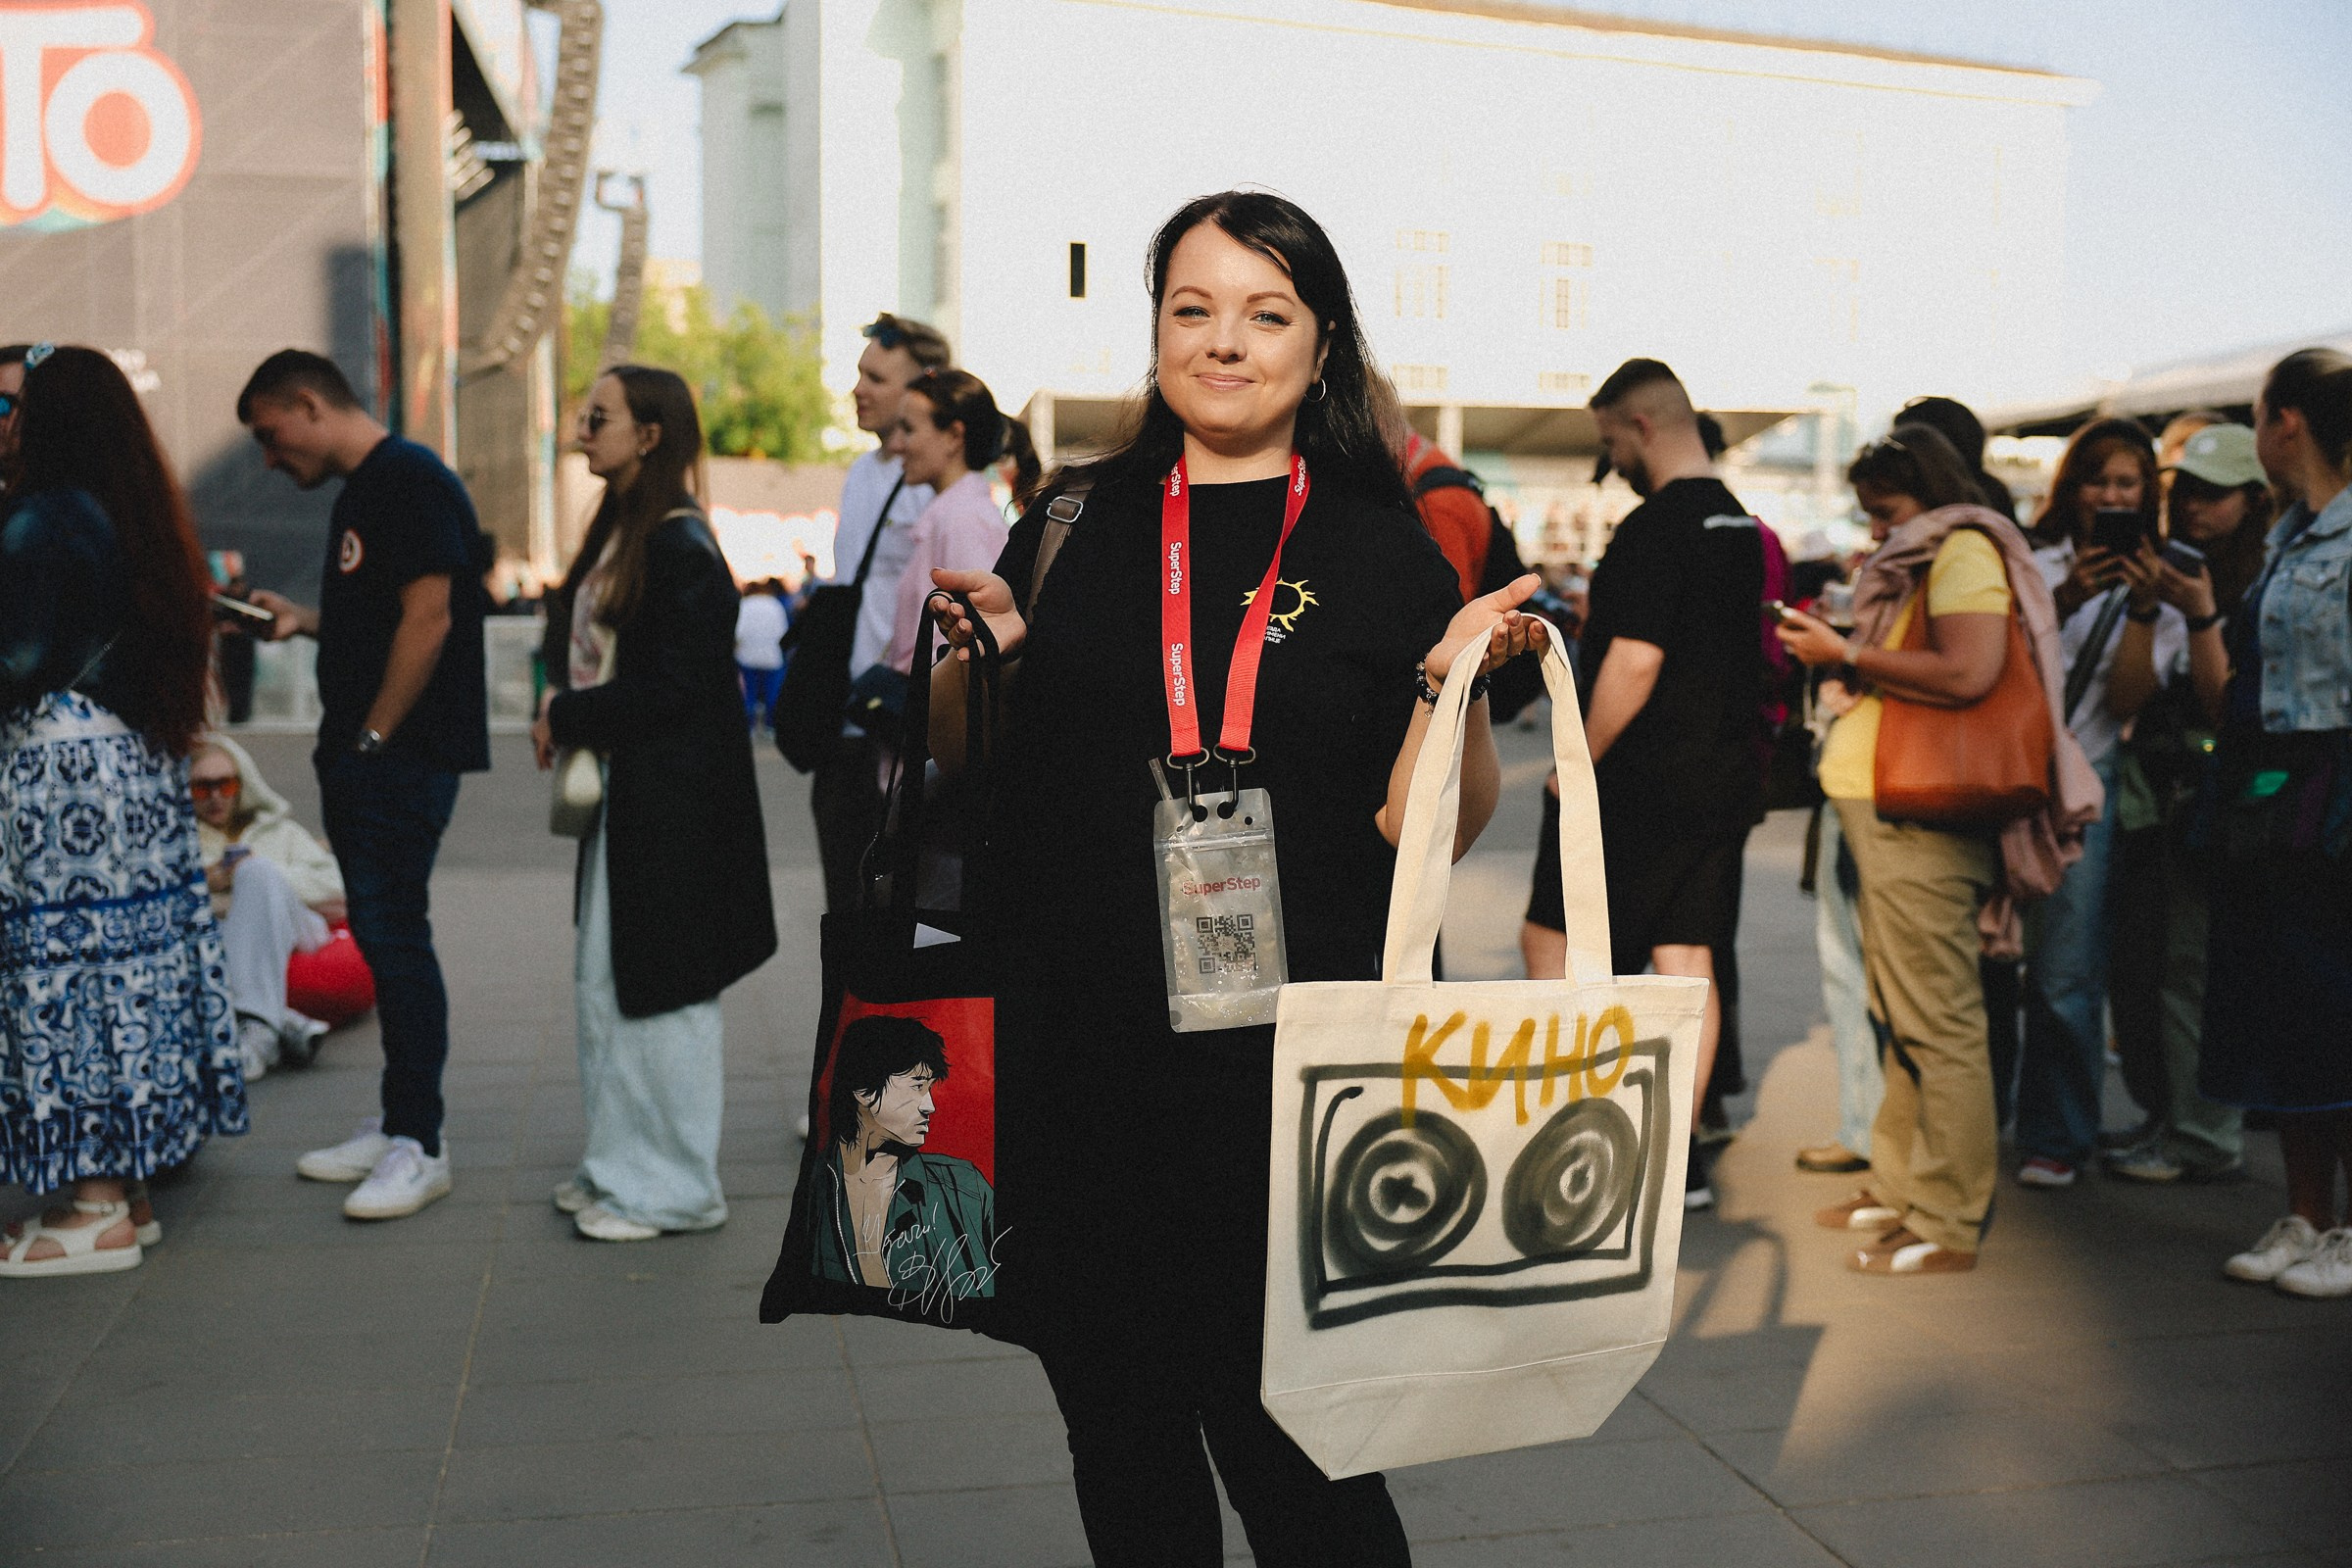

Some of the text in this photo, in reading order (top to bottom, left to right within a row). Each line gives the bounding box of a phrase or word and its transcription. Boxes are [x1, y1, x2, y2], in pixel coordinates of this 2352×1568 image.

[1168, 541, 1183, 595] SuperStep
[1169, 643, 1187, 707] SuperStep
[1181, 876, 1261, 896] SuperStep
[1401, 1004, 1636, 1130] КИНО
